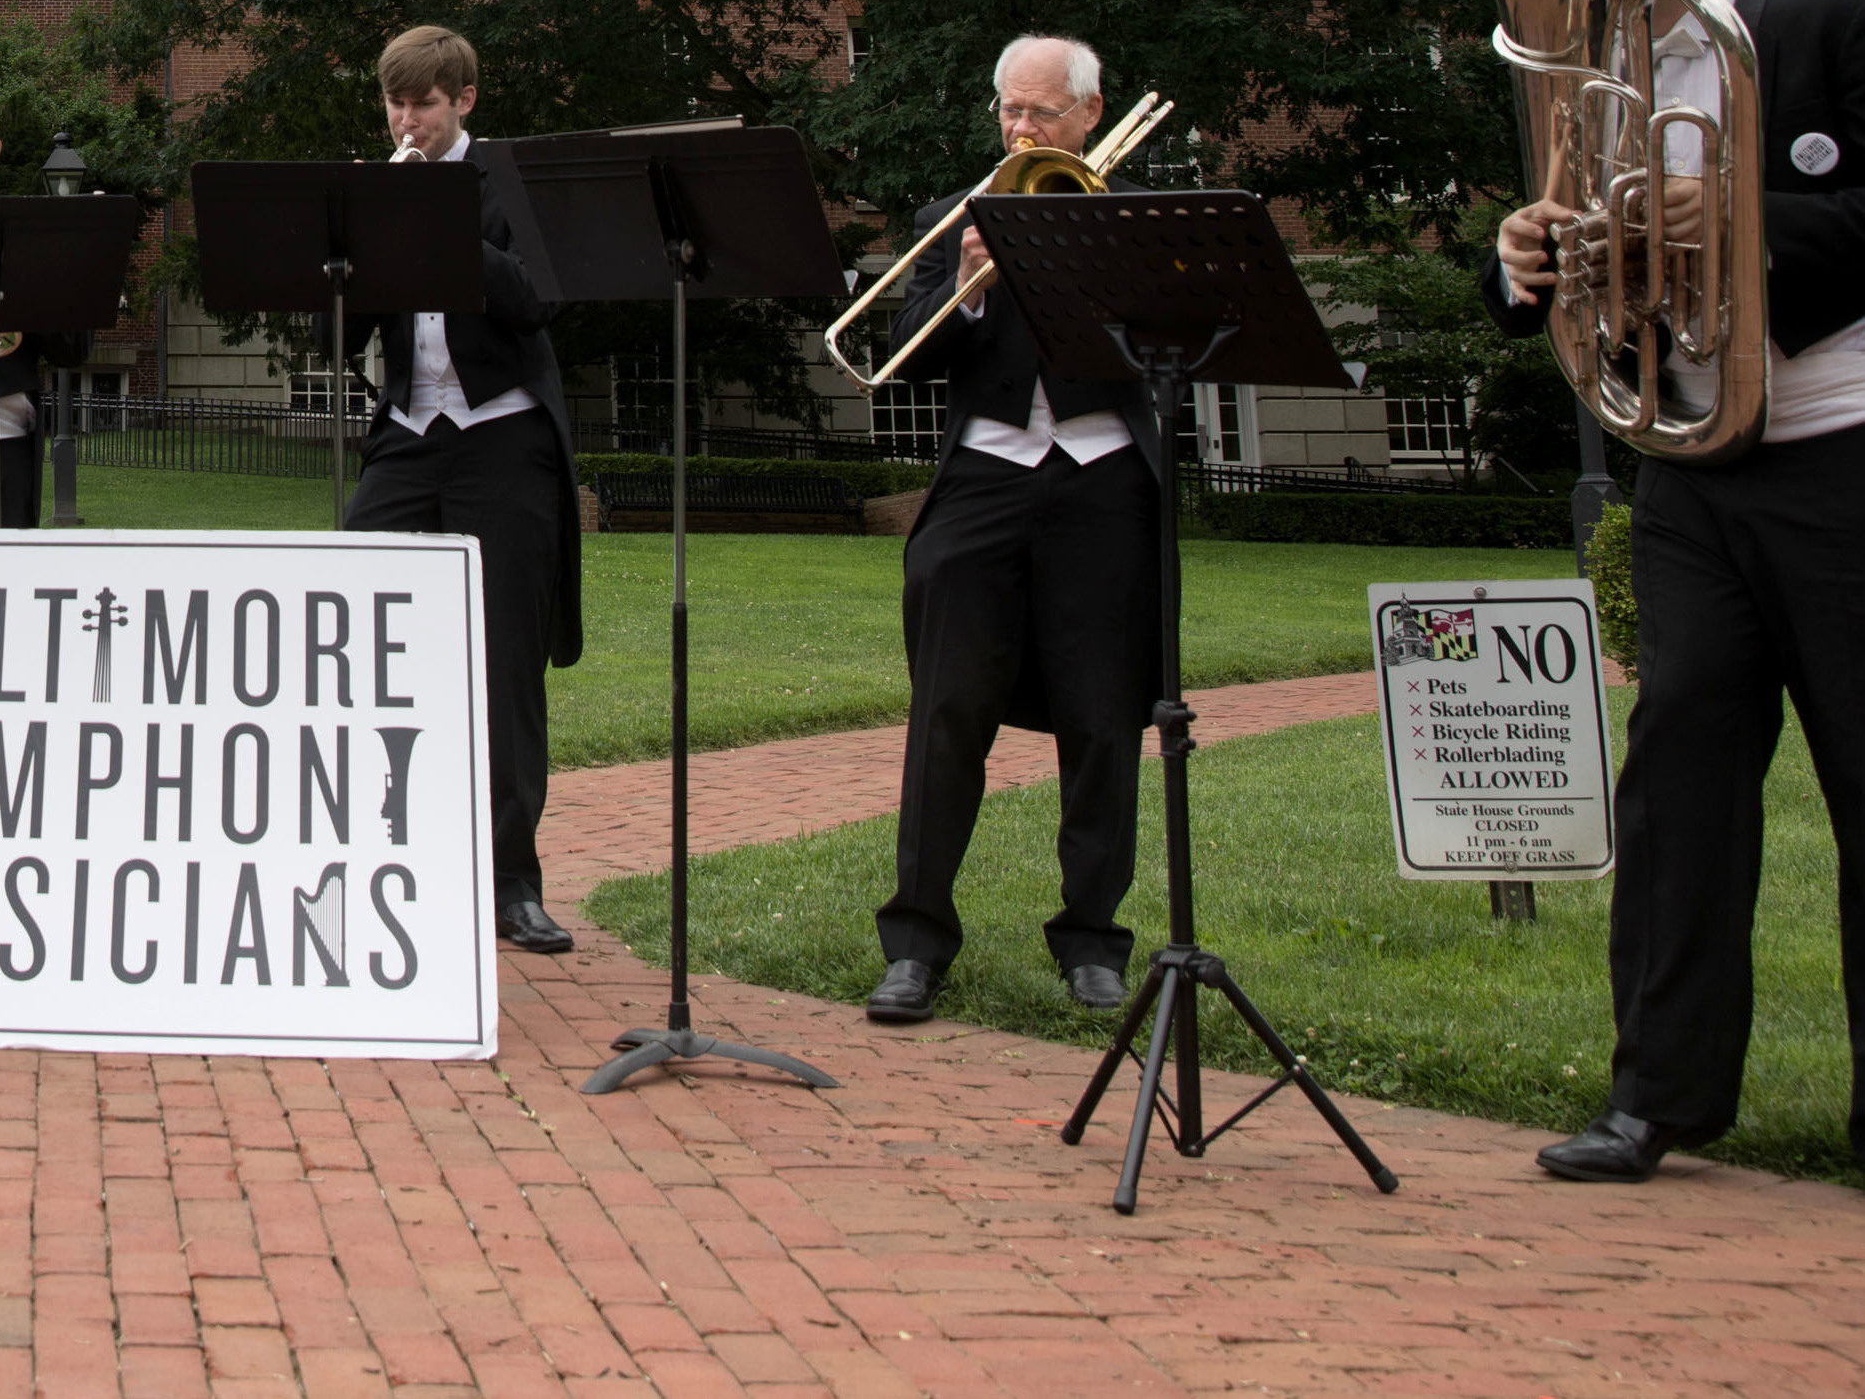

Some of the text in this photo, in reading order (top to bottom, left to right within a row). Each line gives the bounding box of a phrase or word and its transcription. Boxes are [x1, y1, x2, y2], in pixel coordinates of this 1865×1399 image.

[1491, 623, 1577, 684] NO
[1427, 678, 1467, 695] Pets
[1429, 700, 1571, 720] Skateboarding
[1432, 723, 1571, 744] Bicycle Riding
[1435, 746, 1566, 766] Rollerblading
[1440, 770, 1568, 789] ALLOWED
[1435, 804, 1575, 816] State House Grounds
[1475, 819, 1539, 832] CLOSED
[1466, 835, 1480, 847] 11
[1484, 838, 1506, 849] pm
[1519, 835, 1528, 847] 6
[1531, 838, 1552, 847] am
[1445, 850, 1575, 862] KEEP OFF GRASS
